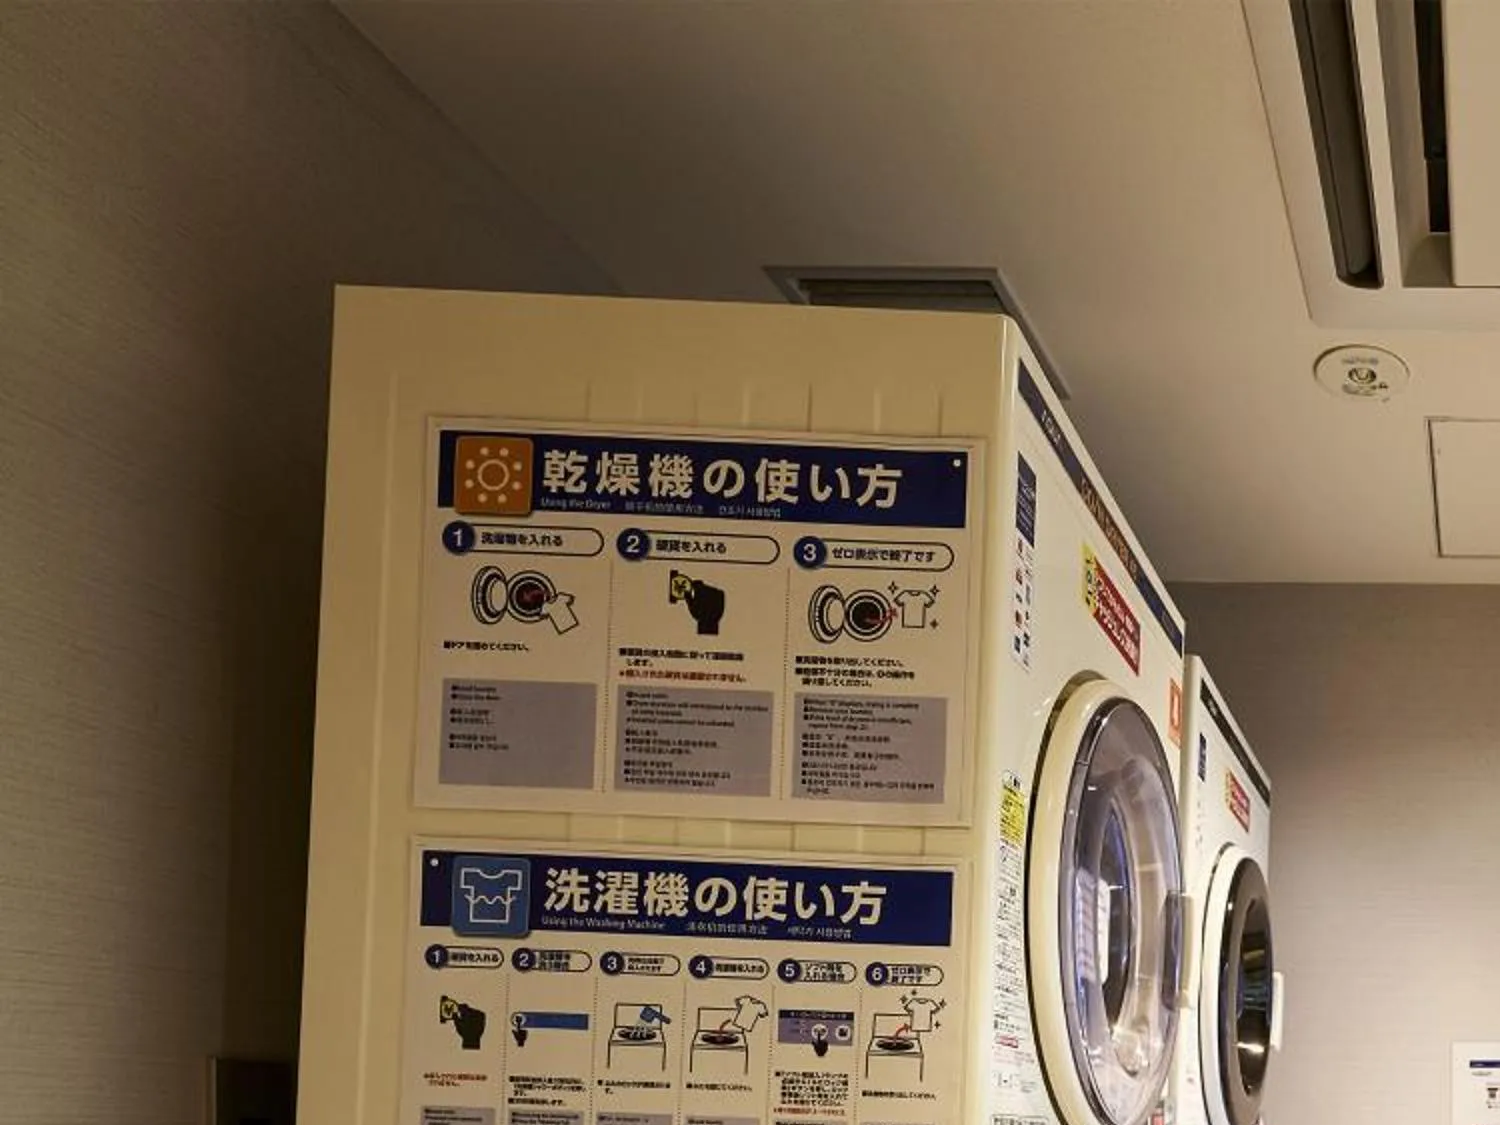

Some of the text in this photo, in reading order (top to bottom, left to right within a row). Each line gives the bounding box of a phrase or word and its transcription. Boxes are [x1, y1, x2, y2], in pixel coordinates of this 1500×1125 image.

[541, 449, 904, 508] 乾燥機の使い方
[453, 531, 463, 546] 1
[627, 536, 641, 553] 2
[803, 544, 817, 562] 3
[543, 868, 888, 926] 洗濯機の使い方
[434, 950, 441, 963] 1
[520, 953, 529, 966] 2
[607, 956, 617, 970] 3
[696, 960, 705, 973] 4
[785, 963, 795, 977] 5
[872, 968, 881, 981] 6
